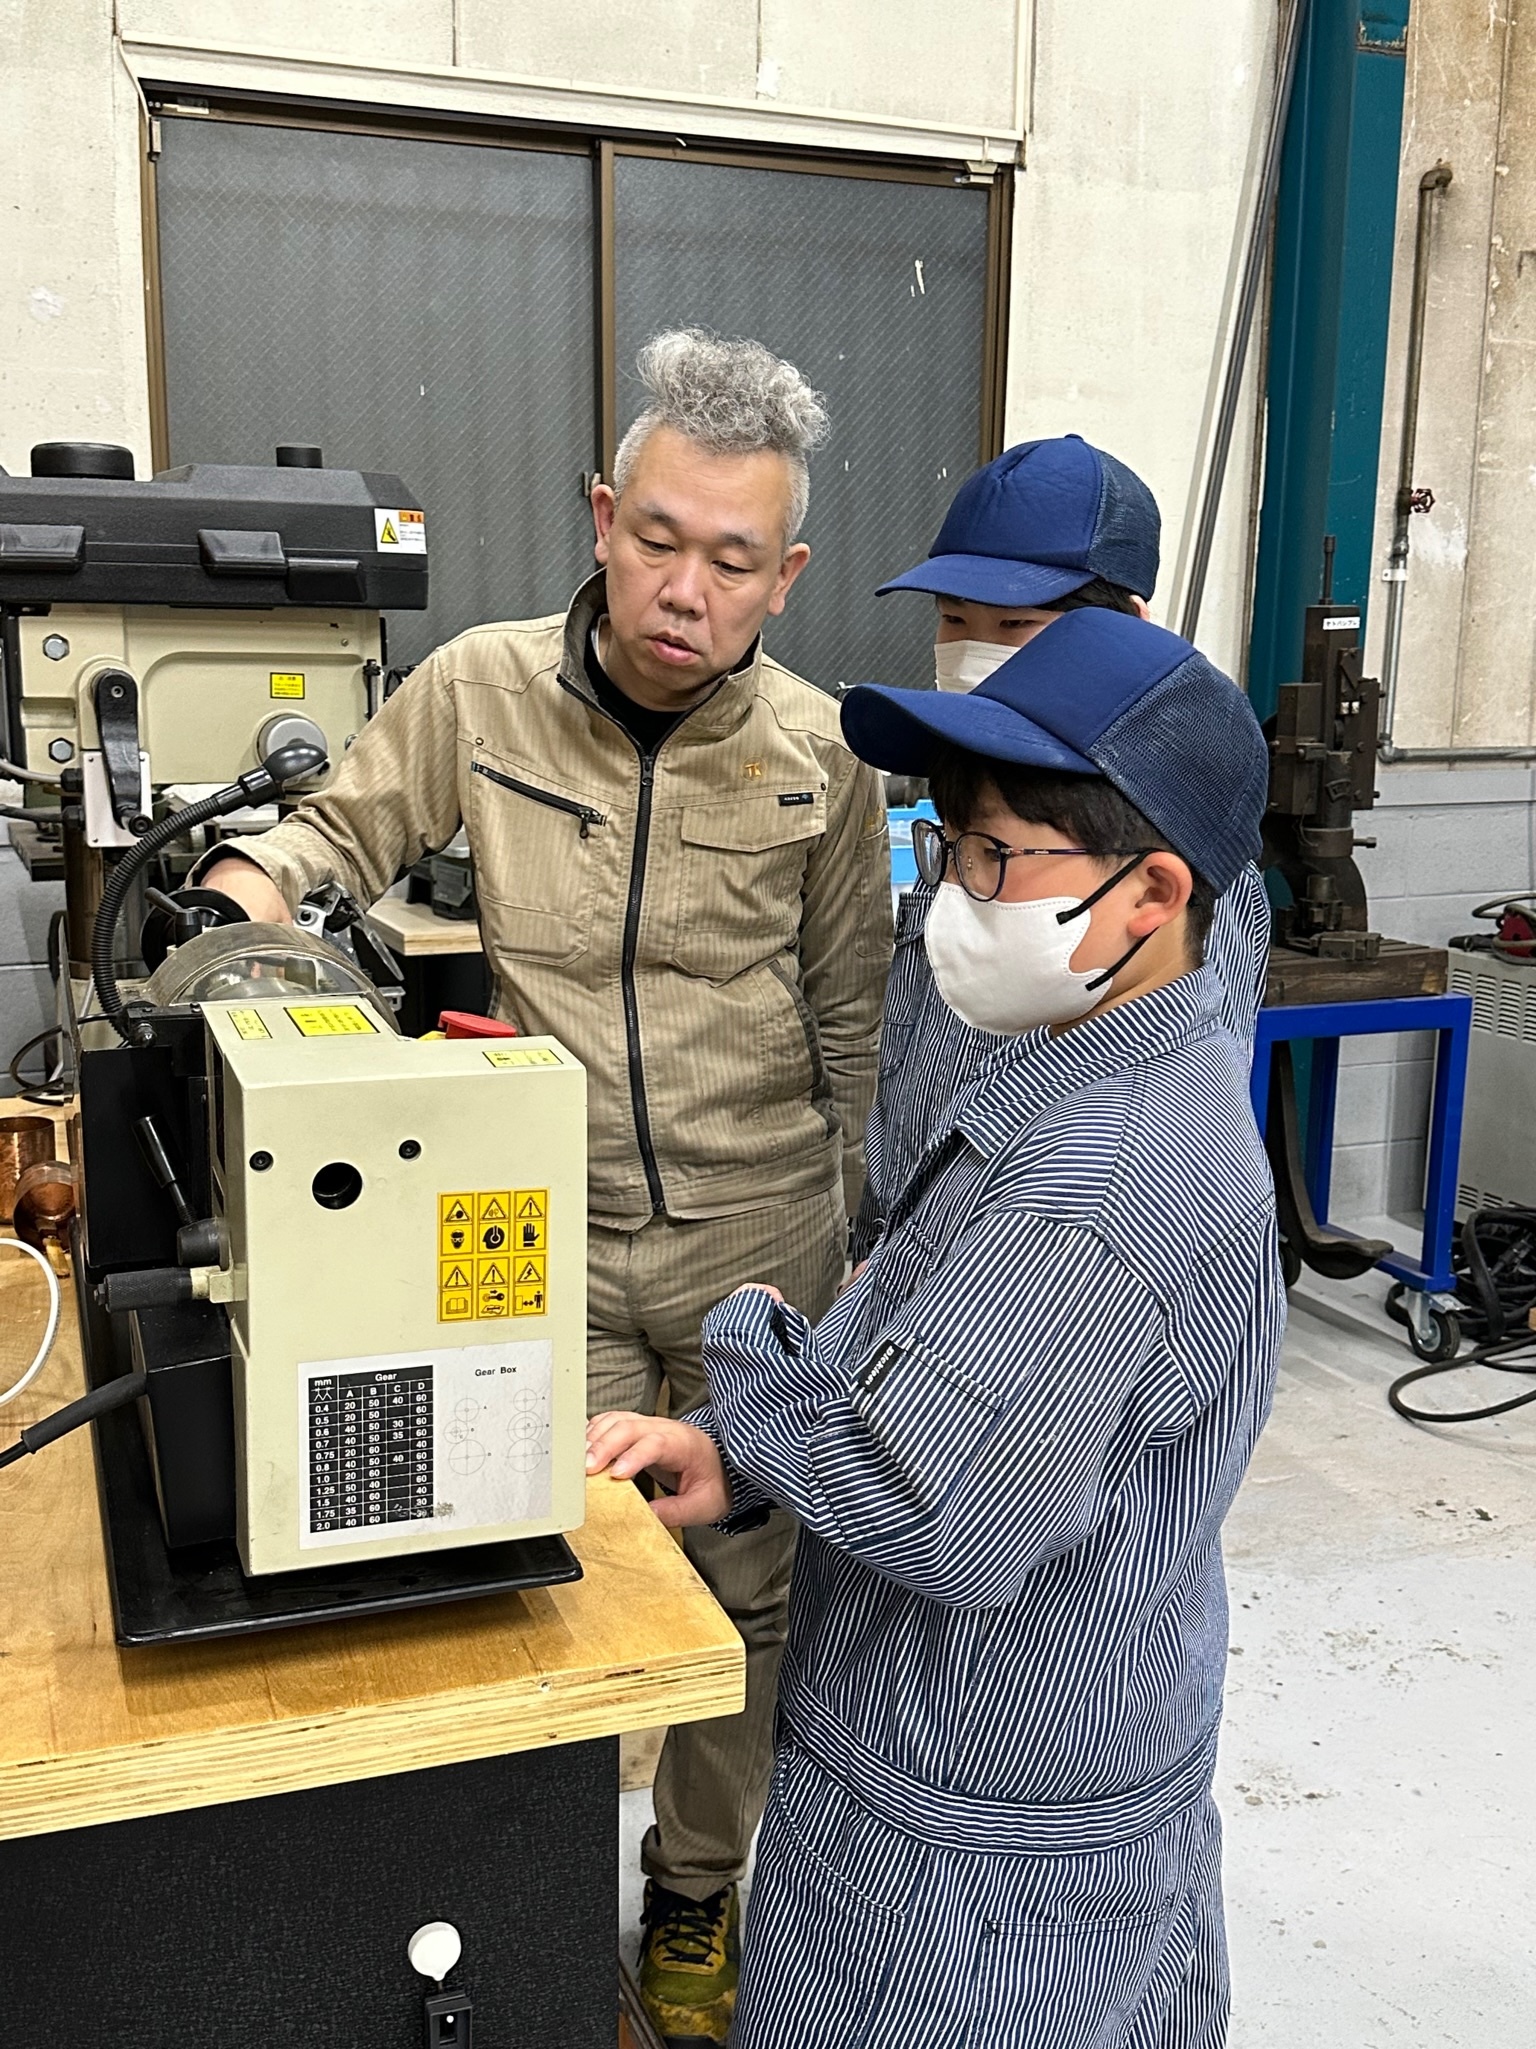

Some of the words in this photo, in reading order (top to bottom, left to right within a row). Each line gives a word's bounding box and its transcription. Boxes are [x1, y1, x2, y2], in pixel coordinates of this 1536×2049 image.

[375, 1373, 397, 1382] Gear
[474, 1368, 495, 1377] Gear
[500, 1366, 517, 1374] Box
[314, 1378, 332, 1387] mm
[346, 1390, 354, 1398] A
[370, 1387, 377, 1395] B
[393, 1385, 401, 1393] C
[418, 1382, 425, 1390] D
[315, 1404, 329, 1413] 0.4
[345, 1402, 356, 1410] 20
[369, 1399, 379, 1407] 50
[392, 1396, 403, 1404] 40
[416, 1394, 427, 1402] 60
[315, 1416, 329, 1425] 0.5
[345, 1413, 356, 1421] 20
[369, 1411, 379, 1419] 50
[416, 1405, 427, 1413] 60
[316, 1428, 329, 1437] 0.6
[345, 1425, 356, 1433] 40
[369, 1422, 380, 1430] 50
[393, 1420, 403, 1428] 30
[416, 1417, 427, 1425] 60
[316, 1440, 329, 1448] 0.7
[345, 1437, 356, 1445] 40
[369, 1434, 380, 1442] 50
[393, 1431, 403, 1439] 35
[416, 1429, 427, 1437] 60
[316, 1451, 335, 1460] 0.75
[345, 1449, 356, 1457] 20
[369, 1446, 380, 1454] 60
[416, 1440, 427, 1448] 40
[316, 1463, 330, 1472] 0.8
[345, 1460, 356, 1468] 40
[369, 1457, 380, 1465] 50
[416, 1452, 427, 1460] 60
[317, 1475, 330, 1483] 1.0
[345, 1472, 356, 1480] 20
[369, 1469, 380, 1477] 60
[416, 1463, 427, 1471] 30
[317, 1486, 335, 1495] 1.25
[345, 1484, 356, 1492] 50
[416, 1475, 427, 1483] 60
[317, 1499, 330, 1507] 1.5
[345, 1495, 356, 1503] 40
[369, 1492, 380, 1500] 60
[416, 1486, 427, 1494] 40
[317, 1510, 335, 1518] 1.75
[345, 1507, 356, 1515] 35
[369, 1504, 380, 1512] 60
[416, 1498, 427, 1506] 30
[317, 1522, 330, 1530] 2.0
[346, 1518, 357, 1526] 40
[369, 1515, 380, 1523] 60
